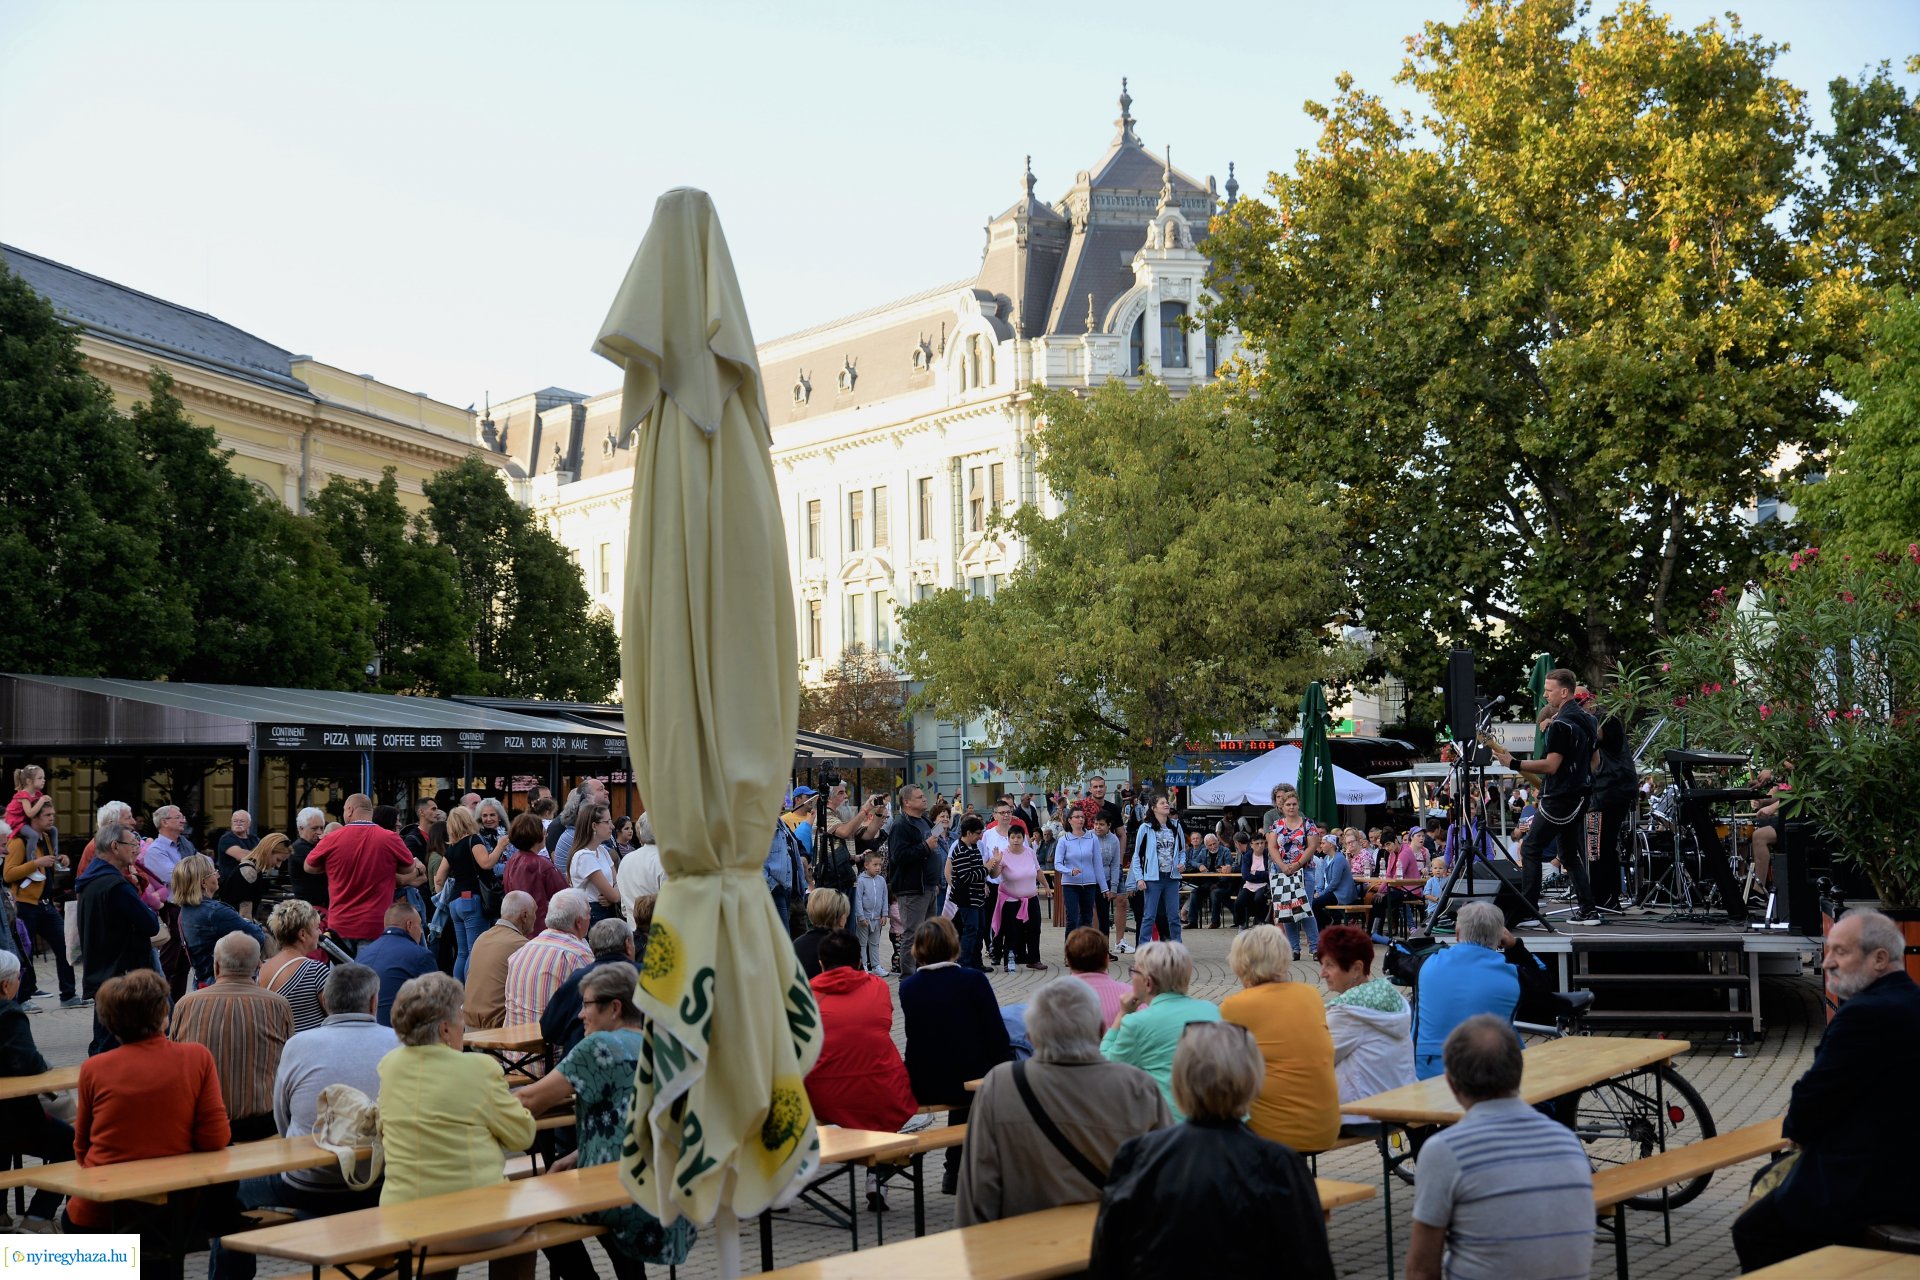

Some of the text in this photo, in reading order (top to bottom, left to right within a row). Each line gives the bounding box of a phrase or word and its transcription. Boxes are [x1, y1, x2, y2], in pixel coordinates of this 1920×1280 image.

[271, 726, 306, 737] CONTINENT
[459, 731, 486, 741] CONTINENT
[323, 732, 443, 747] PIZZA WINE COFFEE BEER
[504, 736, 525, 748] PIZZA
[531, 737, 547, 749] BOR
[571, 736, 589, 750] KÁVÉ
[604, 738, 626, 747] CONTINENT
[1220, 740, 1243, 750] HOT
[1211, 793, 1226, 804] 383
